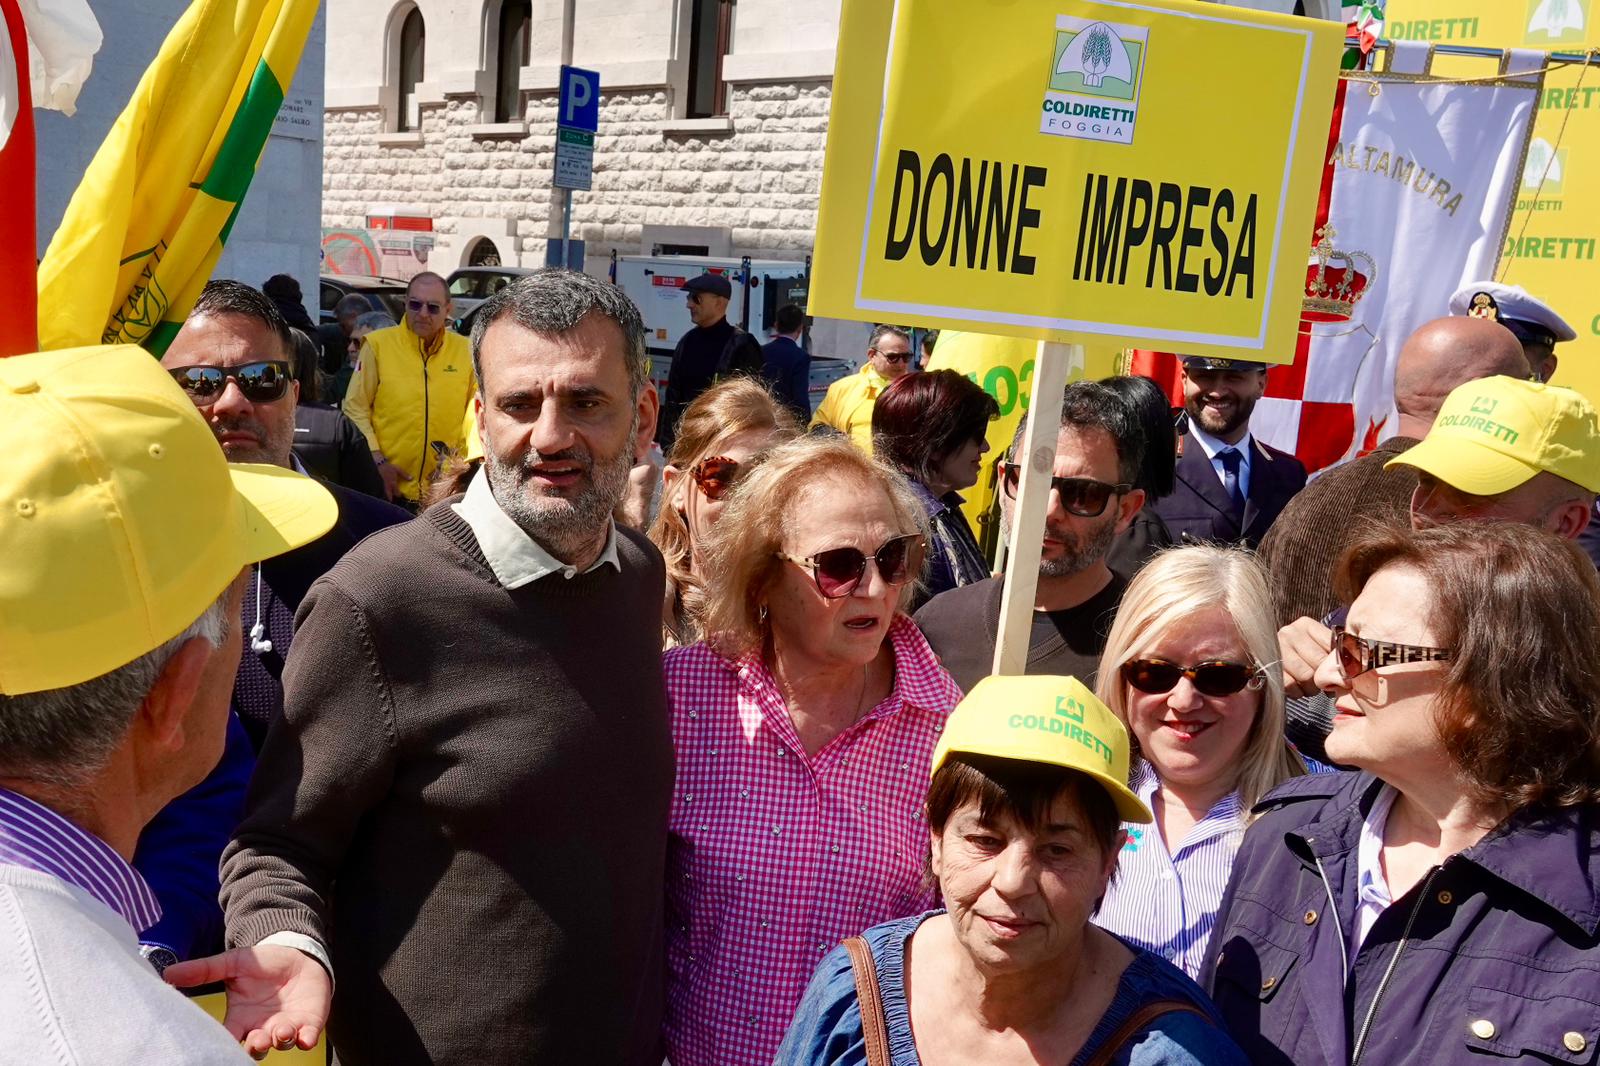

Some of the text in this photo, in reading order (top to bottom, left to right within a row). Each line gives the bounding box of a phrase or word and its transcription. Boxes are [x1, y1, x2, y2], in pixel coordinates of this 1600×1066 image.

[1380, 18, 1480, 41] DIRETTI
[566, 73, 592, 121] P
[1538, 87, 1600, 110] IRET
[1042, 99, 1135, 123] COLDIRETTI
[1048, 118, 1123, 136] FOGGIA
[1328, 142, 1463, 217] ALTAMURA
[1515, 200, 1563, 211] DIRETTI
[884, 149, 1258, 299] DONNE IMPRESA
[1439, 415, 1519, 445] COLDIRETTI
[1008, 714, 1113, 765] COLDIRETTI
